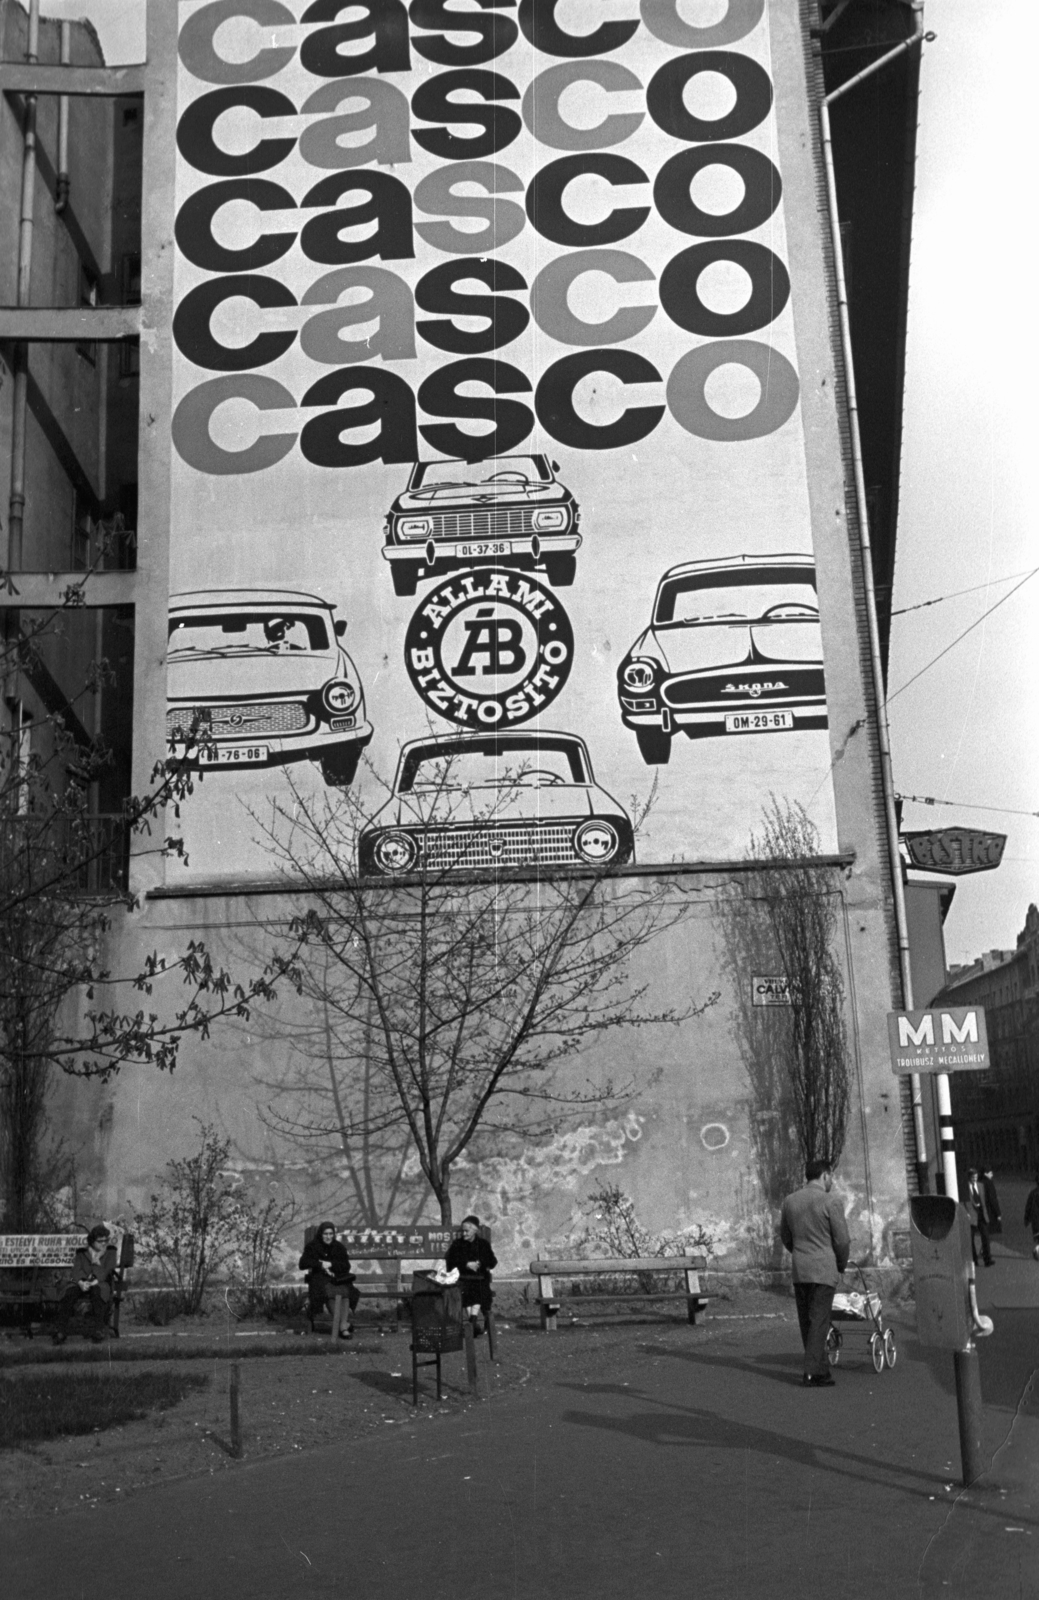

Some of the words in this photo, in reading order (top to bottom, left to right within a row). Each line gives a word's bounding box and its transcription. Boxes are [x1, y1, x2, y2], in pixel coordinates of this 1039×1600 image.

[177, 0, 766, 85] casco
[176, 50, 773, 177] casco
[174, 142, 783, 272] casco
[172, 239, 791, 372] casco
[171, 339, 800, 475] casco
[461, 543, 505, 555] OL-37-36
[421, 574, 555, 629] ÁLLAMI
[450, 607, 527, 677] ÁB
[411, 640, 568, 723] BIZTOSÍTÓ
[733, 714, 786, 729] OM-29-61
[896, 1056, 934, 1067] TROLIBUSZ
[898, 1011, 979, 1047] MM
[37, 1236, 62, 1247] RUHA
